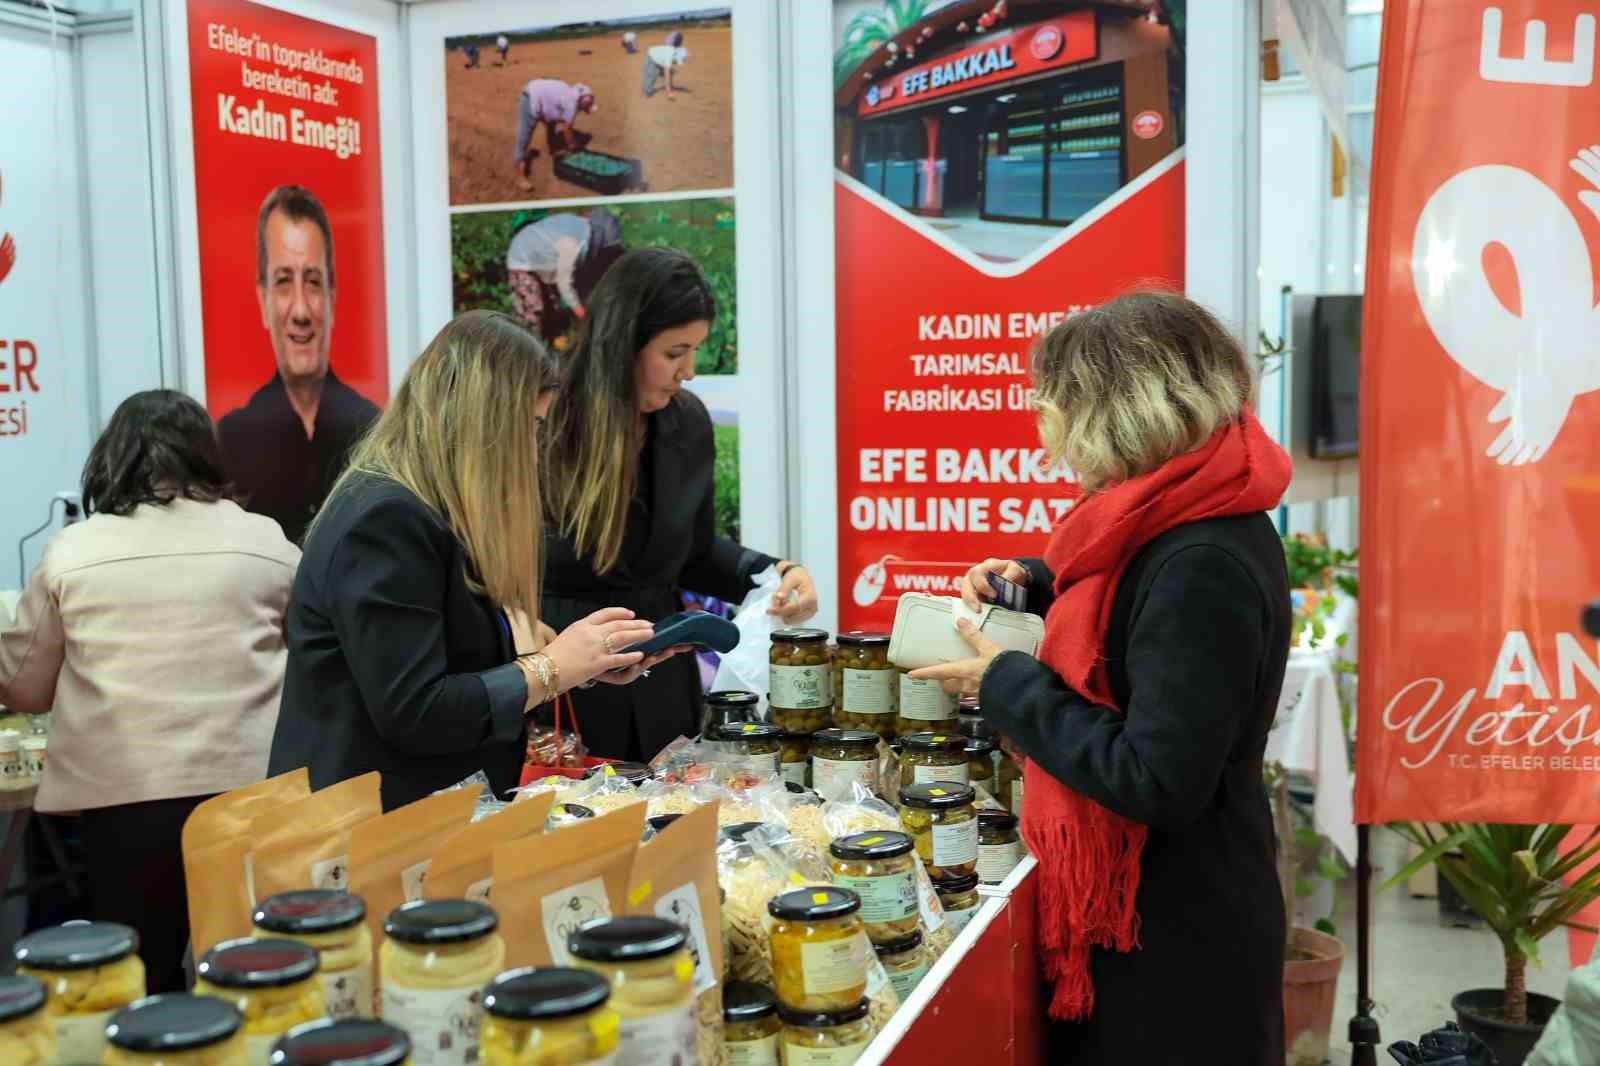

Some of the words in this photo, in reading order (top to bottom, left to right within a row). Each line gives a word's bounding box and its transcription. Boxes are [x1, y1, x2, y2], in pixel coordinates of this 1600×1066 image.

[207, 23, 271, 62] Efeler'in
[272, 43, 364, 85] topraklarında
[901, 71, 929, 97] EFE
[931, 44, 1015, 87] BAKKAL
[241, 60, 311, 101] bereketin
[217, 92, 288, 142] Kadın
[290, 107, 362, 159] Emeği!
[918, 313, 1001, 341] KADIN
[910, 352, 1026, 376] TARIMSAL
[883, 384, 1002, 412] FABRİKASI
[859, 447, 928, 484] EFE
[935, 447, 1083, 484] BAKKA
[850, 495, 992, 533] ONLINE
[1383, 676, 1600, 769] Yetiş
[1480, 753, 1545, 770] EFELER
